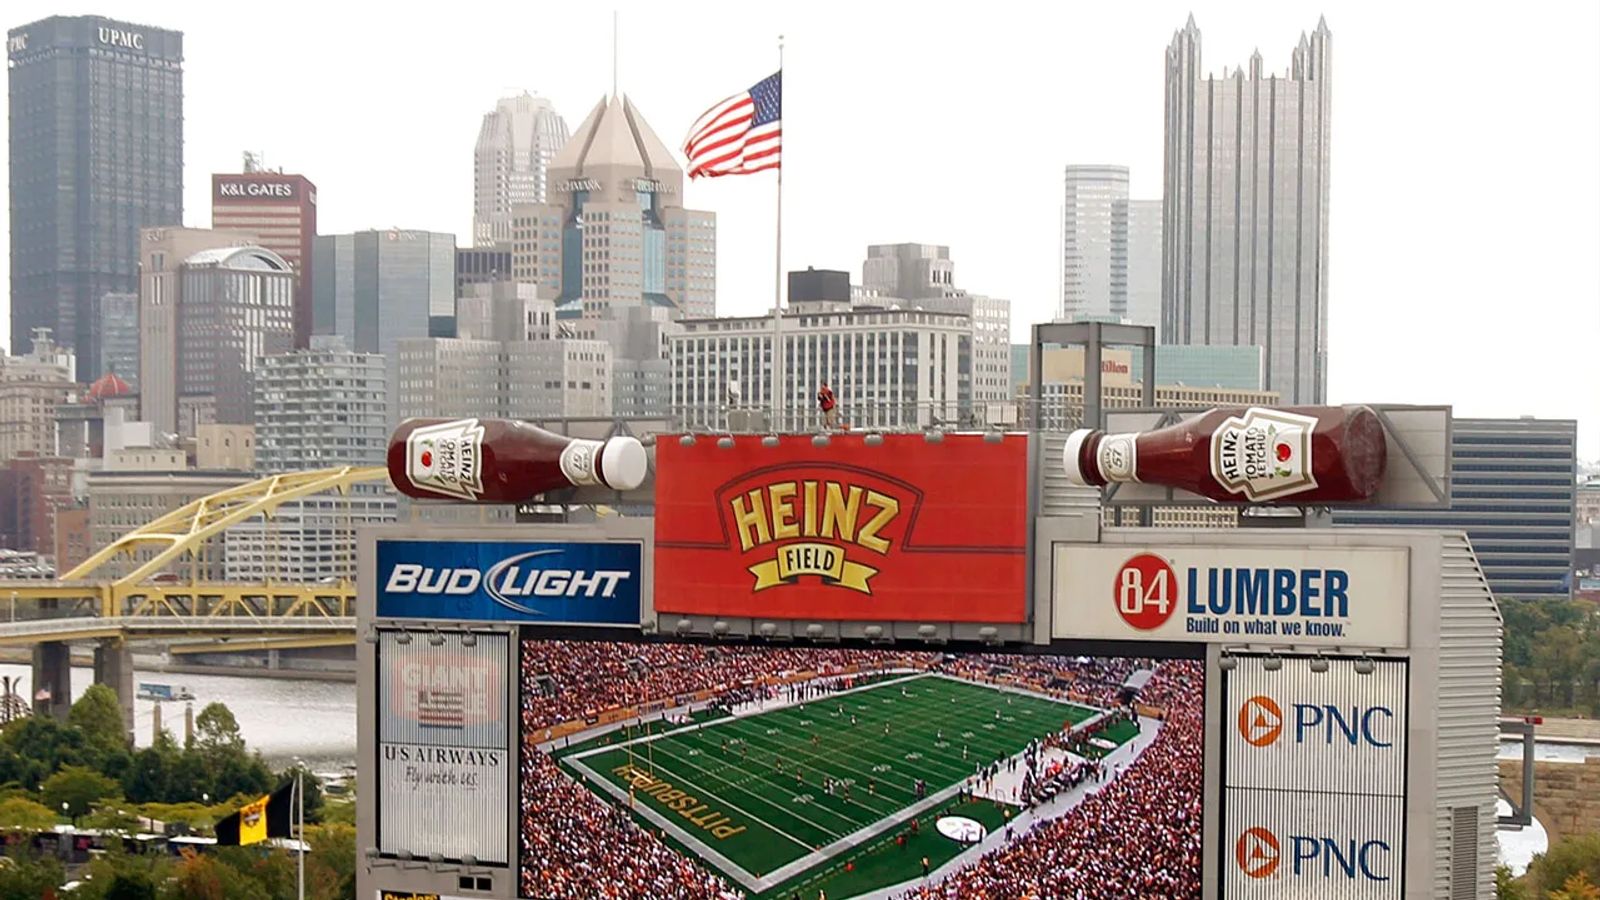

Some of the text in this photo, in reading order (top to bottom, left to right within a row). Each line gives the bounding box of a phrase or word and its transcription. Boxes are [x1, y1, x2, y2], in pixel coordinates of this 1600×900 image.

[8, 33, 29, 52] PMC
[98, 27, 144, 50] UPMC
[220, 183, 292, 197] K&L GATES
[573, 453, 583, 470] 57
[1112, 449, 1122, 468] 57
[1223, 430, 1240, 480] HEINZ
[1245, 427, 1258, 480] TOMATO
[730, 478, 899, 555] HEINZ
[785, 548, 836, 572] FIELD
[385, 563, 631, 597] BUD LIGHT
[1119, 567, 1350, 618] 84 LUMBER
[1186, 617, 1346, 637] Build on what we know.
[401, 663, 488, 688] GIANT
[403, 688, 488, 716] ELE
[1292, 703, 1393, 748] PNC
[385, 746, 499, 767] US AIRWAYS
[1289, 835, 1390, 881] PNC
